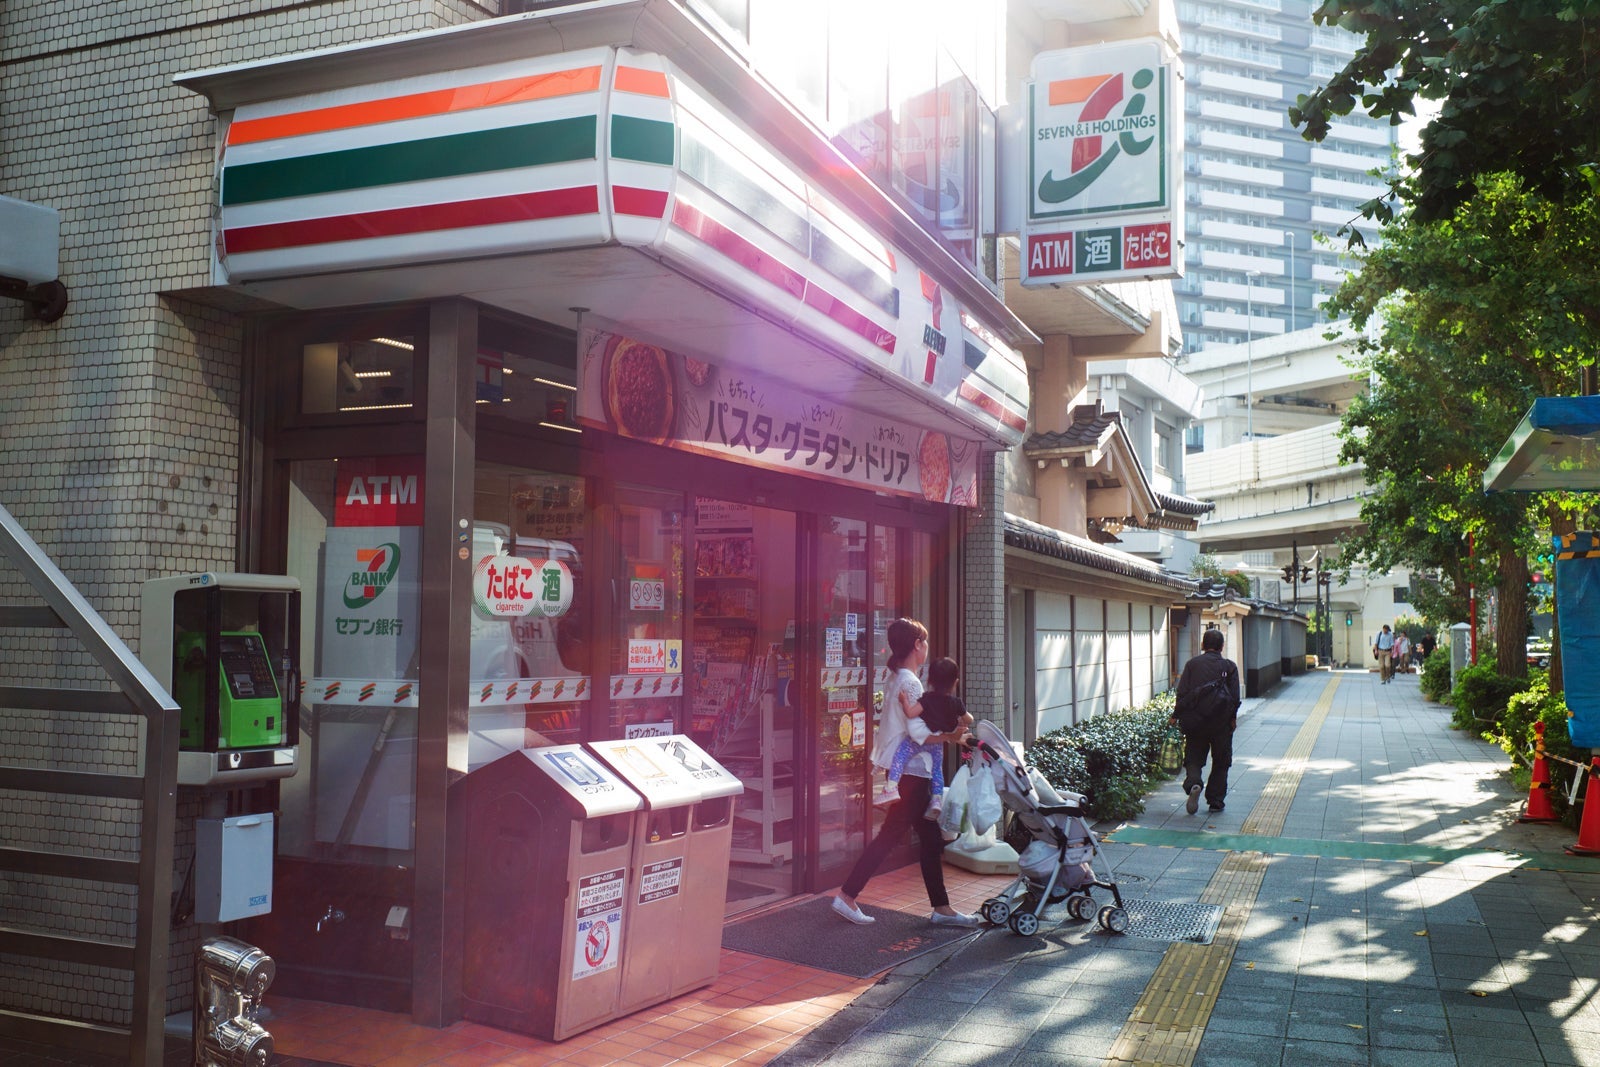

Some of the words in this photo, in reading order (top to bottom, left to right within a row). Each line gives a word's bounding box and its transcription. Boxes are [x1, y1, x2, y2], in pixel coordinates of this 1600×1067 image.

[1038, 122, 1090, 141] SEVEN&i
[1092, 114, 1156, 136] HOLDINGS
[1030, 239, 1071, 270] ATM
[1084, 235, 1113, 267] 酒
[1126, 231, 1169, 262] たばこ
[704, 399, 910, 485] パスタ・グラタン・ドリア
[345, 475, 418, 505] ATM
[351, 570, 391, 588] BANK
[486, 563, 534, 601] たばこ
[541, 567, 562, 603] 酒
[495, 601, 525, 613] cigarette
[543, 603, 561, 613] liquor
[334, 616, 404, 636] セブン銀行
